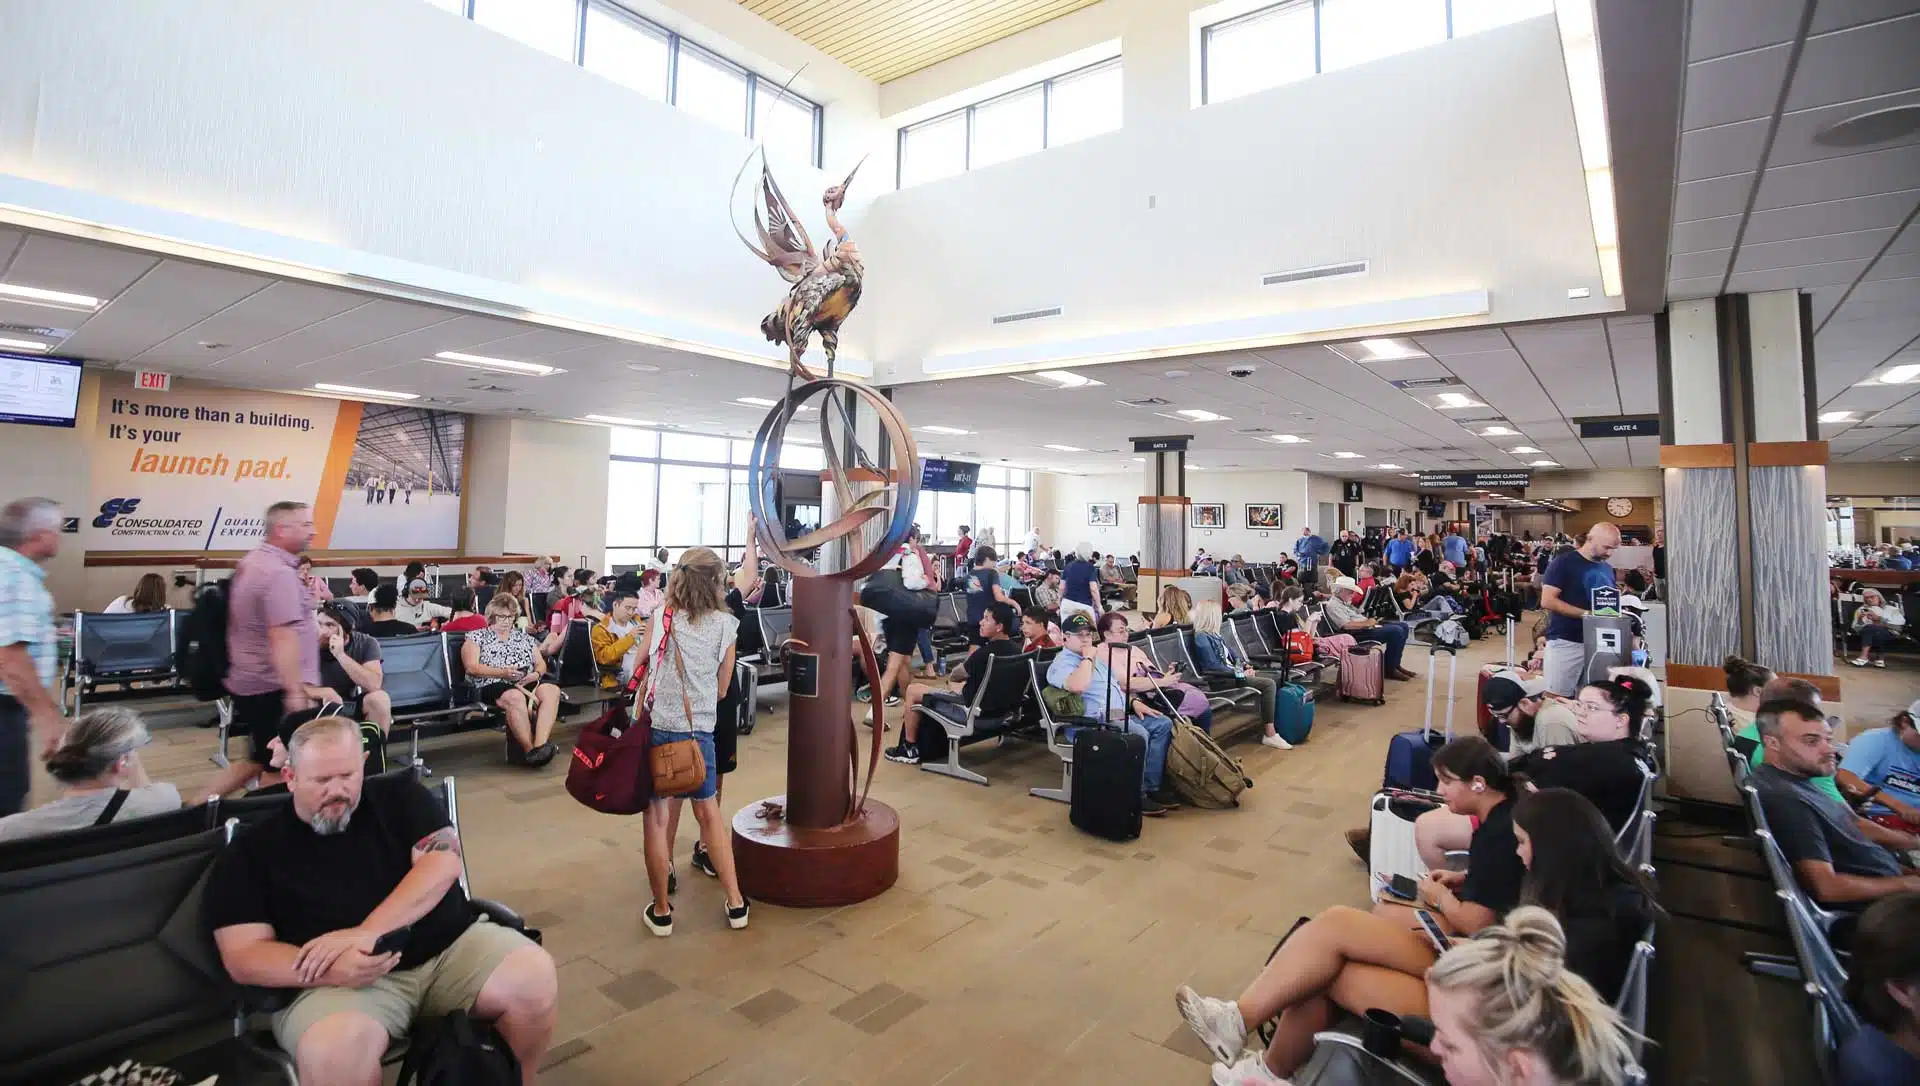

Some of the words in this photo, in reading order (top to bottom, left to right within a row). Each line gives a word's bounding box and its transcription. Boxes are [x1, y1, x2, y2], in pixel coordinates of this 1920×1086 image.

[141, 371, 167, 388] EXIT
[111, 398, 139, 416] It's
[144, 404, 189, 420] more
[194, 406, 230, 423] than
[234, 412, 244, 424] a
[249, 410, 315, 432] building.
[109, 423, 137, 441] It's
[142, 428, 181, 445] your
[130, 447, 229, 477] launch
[233, 455, 291, 482] pad.
[220, 528, 269, 536] EXPERIE
[224, 518, 266, 527] QUALIT
